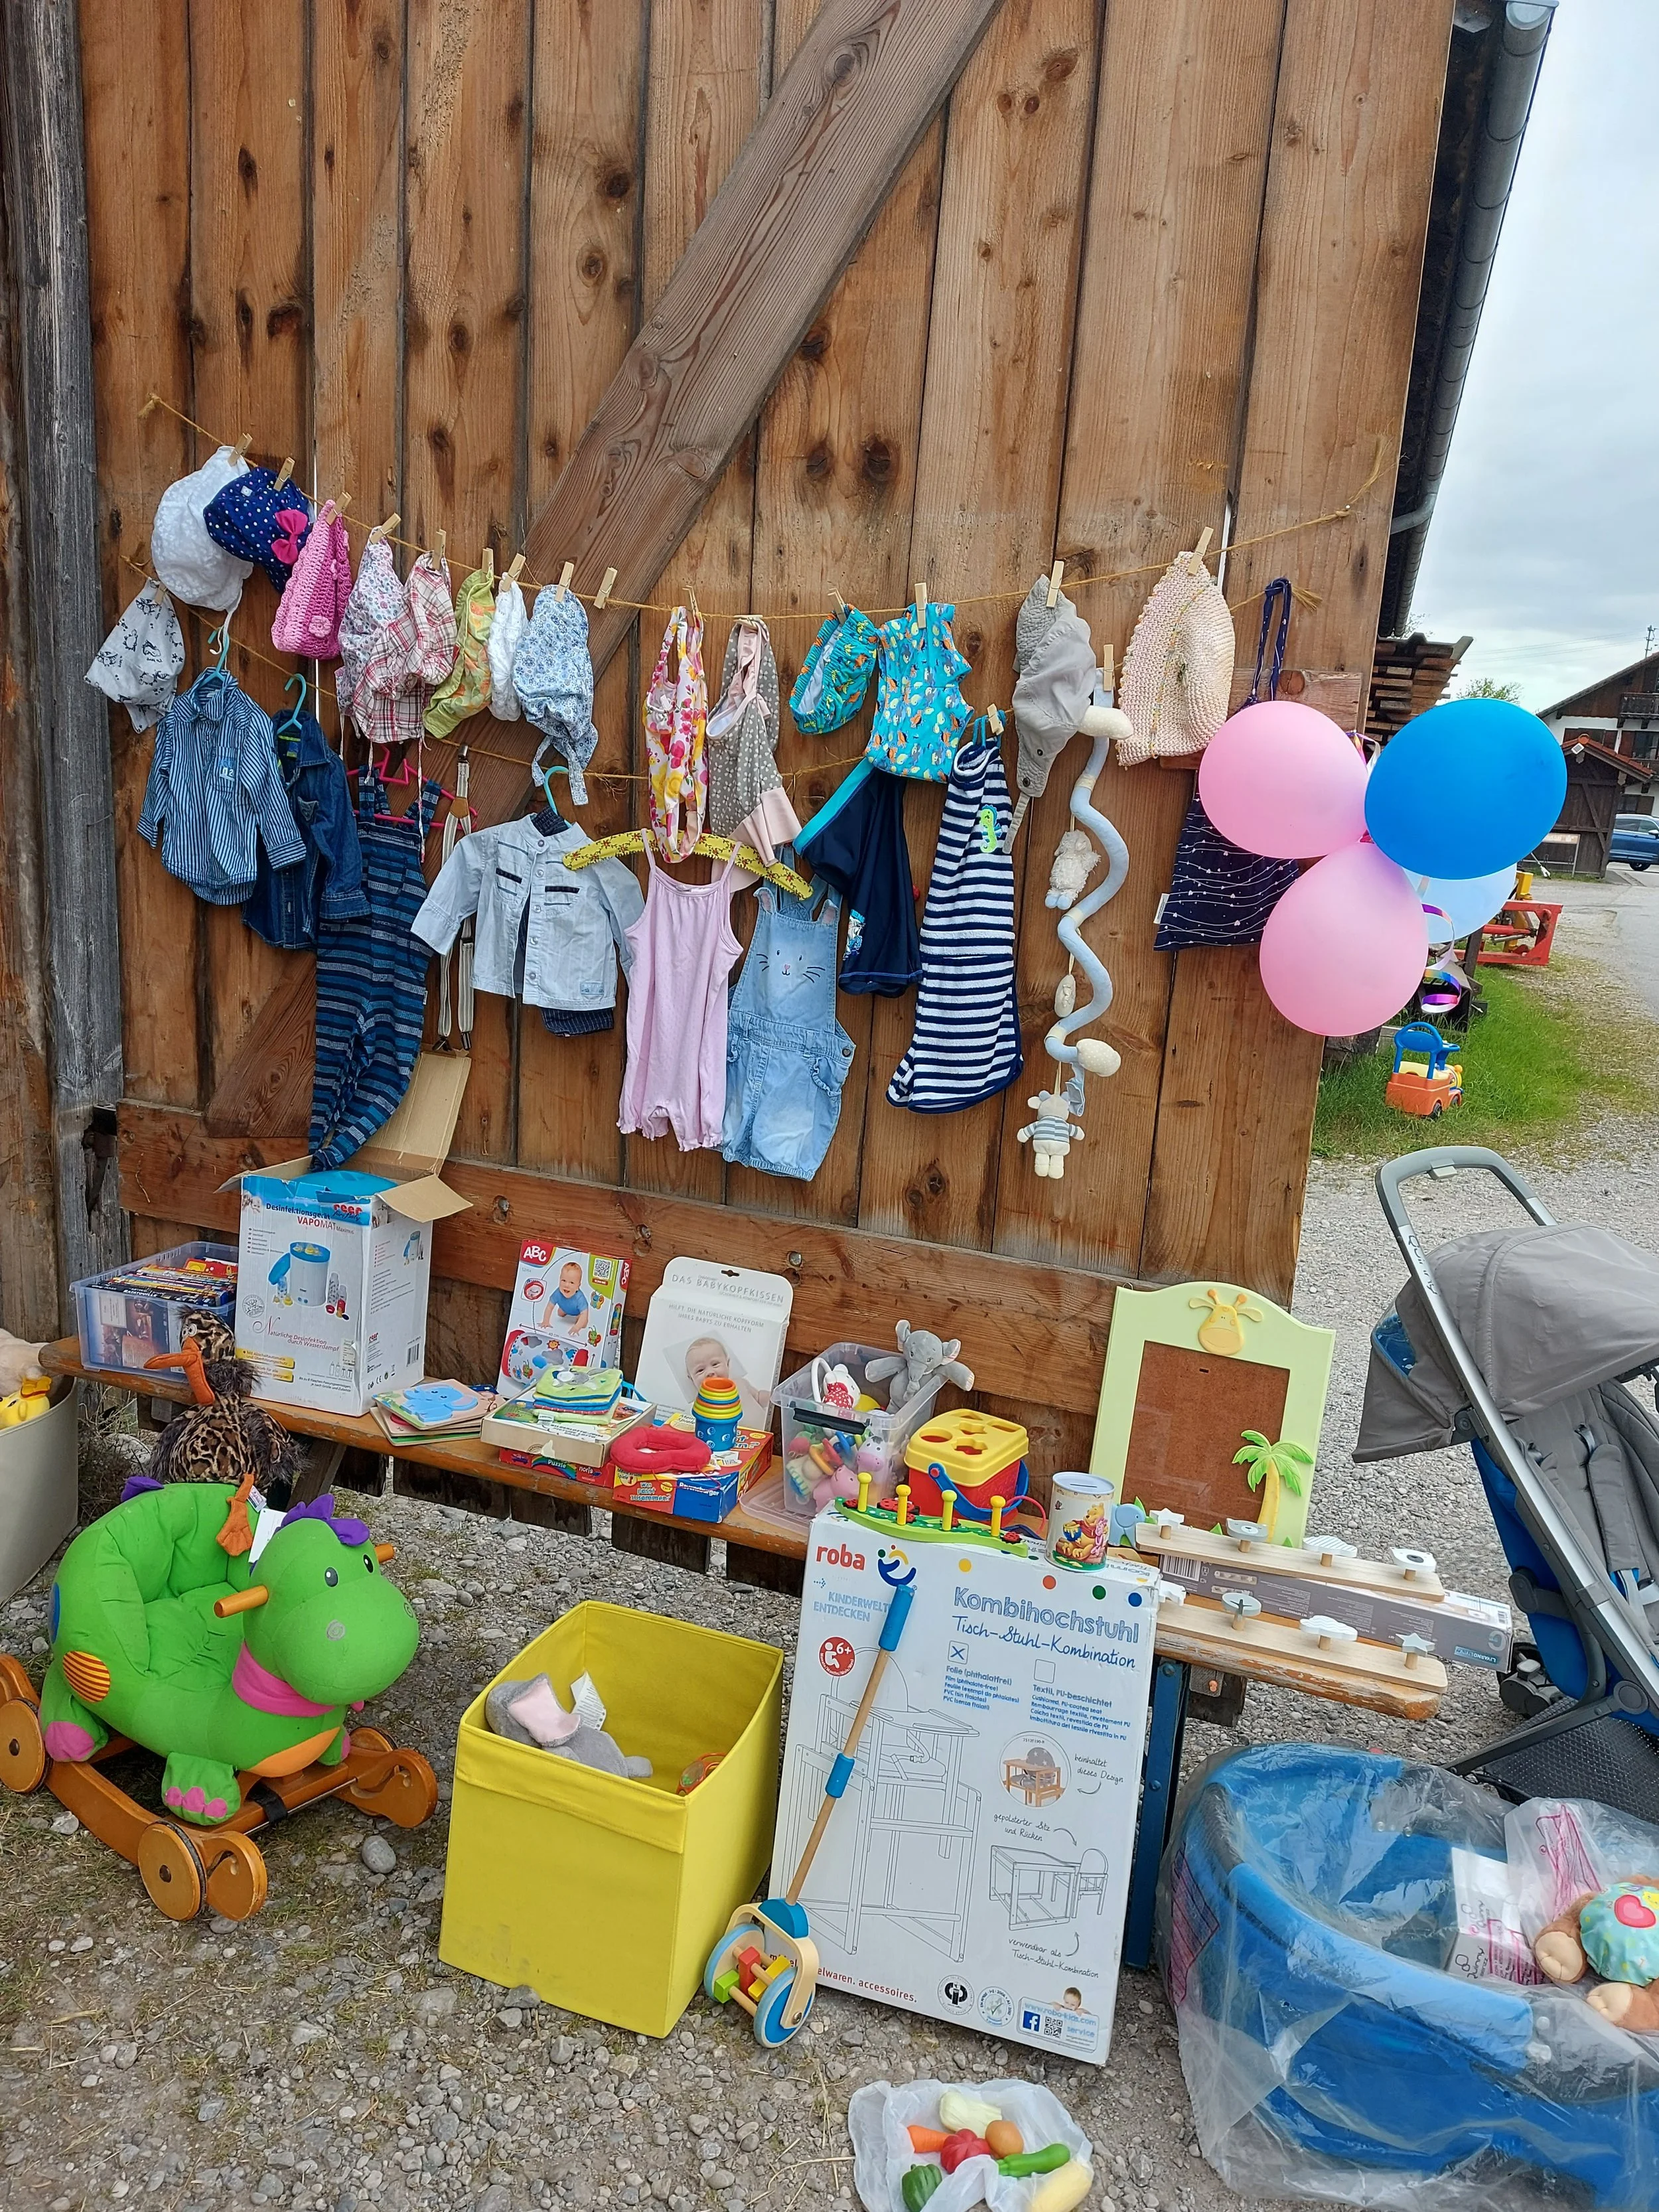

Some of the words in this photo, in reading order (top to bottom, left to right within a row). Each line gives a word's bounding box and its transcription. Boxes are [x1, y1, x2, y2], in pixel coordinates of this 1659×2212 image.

[333, 1204, 363, 1215] reer
[297, 1216, 336, 1231] VAPOMAT
[523, 1245, 547, 1262] ABC
[621, 1262, 630, 1285] ABC
[672, 1274, 692, 1284] DAS
[697, 1279, 784, 1303] BABYKOPFKISSEN
[695, 1316, 713, 1325] BABYS
[723, 1321, 752, 1333] ERHALTEN
[733, 1315, 764, 1327] KOPFFORM
[252, 1315, 293, 1340] Natürliche
[293, 1335, 327, 1345] Desinfektion
[304, 1341, 339, 1351] Wasserdampf
[547, 1459, 567, 1469] Puzzle
[579, 1465, 594, 1474] noris
[816, 1544, 866, 1571] roba
[828, 1591, 891, 1613] KINDERWELT
[813, 1601, 871, 1622] ENTDECKEN
[954, 1586, 1139, 1643] Kombihochstuhl
[836, 1642, 852, 1655] 6+
[952, 1615, 1136, 1668] Tisch-Stuhl-Kombination
[946, 1665, 963, 1674] Folie
[964, 1668, 1012, 1686] (phthalatfrei)
[957, 1677, 998, 1692] (phthalate-free)
[1033, 1684, 1054, 1696] Textil,
[1056, 1689, 1112, 1708] PU-beschichtet
[1031, 1702, 1068, 1714] Rembourrage
[1061, 1701, 1089, 1712] PU-coated
[1029, 1715, 1060, 1727] Imbottitura
[1089, 1728, 1113, 1738] rivestita
[1066, 1716, 1092, 1727] revestida
[1074, 1753, 1108, 1767] beinhaltet
[1077, 1767, 1098, 1778] dieses
[1100, 1770, 1124, 1786] Design
[993, 1813, 1033, 1826] gepolsterter
[1005, 1827, 1017, 1836] und
[1019, 1828, 1043, 1842] Rücken
[1008, 1938, 1048, 1953] verwendbar
[1050, 1949, 1062, 1958] als
[1012, 1949, 1099, 1978] Tisch-Stuhl-Kombination
[818, 1967, 856, 1985] elwaren.
[858, 1978, 918, 2003] accessoires.
[1066, 2026, 1095, 2038] service
